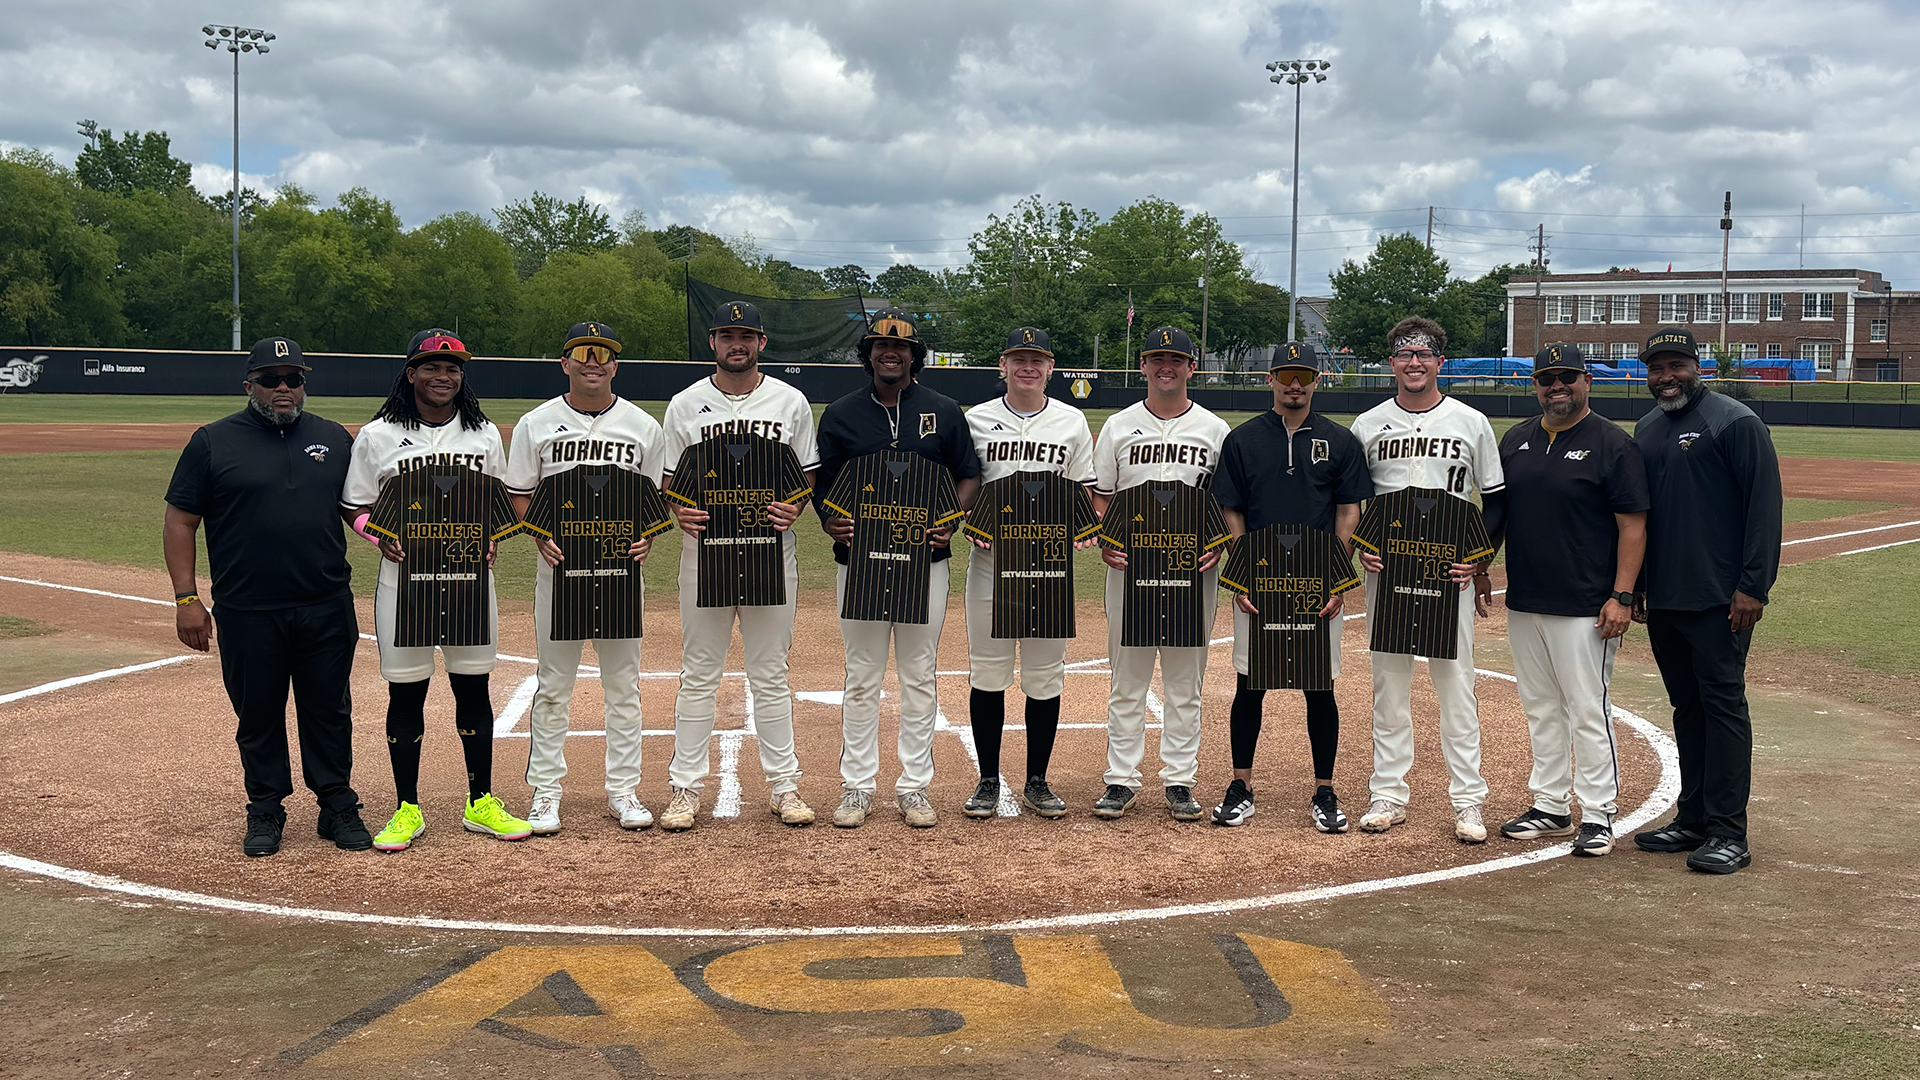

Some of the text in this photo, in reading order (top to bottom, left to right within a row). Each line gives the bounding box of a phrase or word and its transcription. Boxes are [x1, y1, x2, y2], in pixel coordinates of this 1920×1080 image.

[1665, 335, 1687, 344] STATE
[101, 363, 115, 372] Alfa
[116, 364, 146, 373] Insurance
[784, 366, 801, 374] 400
[1076, 380, 1086, 398] 1
[700, 419, 783, 442] HORNETS
[551, 439, 636, 464] HORNETS
[986, 440, 1068, 466] HORNETS
[1128, 442, 1208, 468] HORNETS
[1377, 437, 1462, 461] HORNETS
[397, 453, 485, 474] HORNETS
[1446, 465, 1467, 493] 18
[703, 489, 775, 506] HORNETS
[740, 505, 774, 528] 33
[860, 503, 929, 523] HORNETS
[406, 523, 483, 539] HORNETS
[560, 520, 634, 537] HORNETS
[892, 522, 927, 546] 30
[1000, 524, 1067, 540] HORNETS
[602, 537, 633, 559] 13
[703, 536, 777, 546] CAMDEN MATTHEWS
[1131, 533, 1197, 549] HORNETS
[1387, 539, 1457, 559] HORNETS
[446, 540, 482, 563] 44
[1043, 541, 1067, 562] 11
[1168, 549, 1198, 571] 19
[410, 573, 477, 581] DEVIN CHANDLER
[565, 568, 628, 577] MIGUEL OROPEZA
[1044, 570, 1066, 578] MANN
[1424, 559, 1454, 582] 18
[1136, 579, 1192, 587] CALEB SANDERS
[1255, 577, 1324, 592] HORNETS
[1394, 585, 1442, 598] CAIO ARAUJO
[1295, 593, 1323, 614] 12
[264, 934, 1392, 1079] ASU
